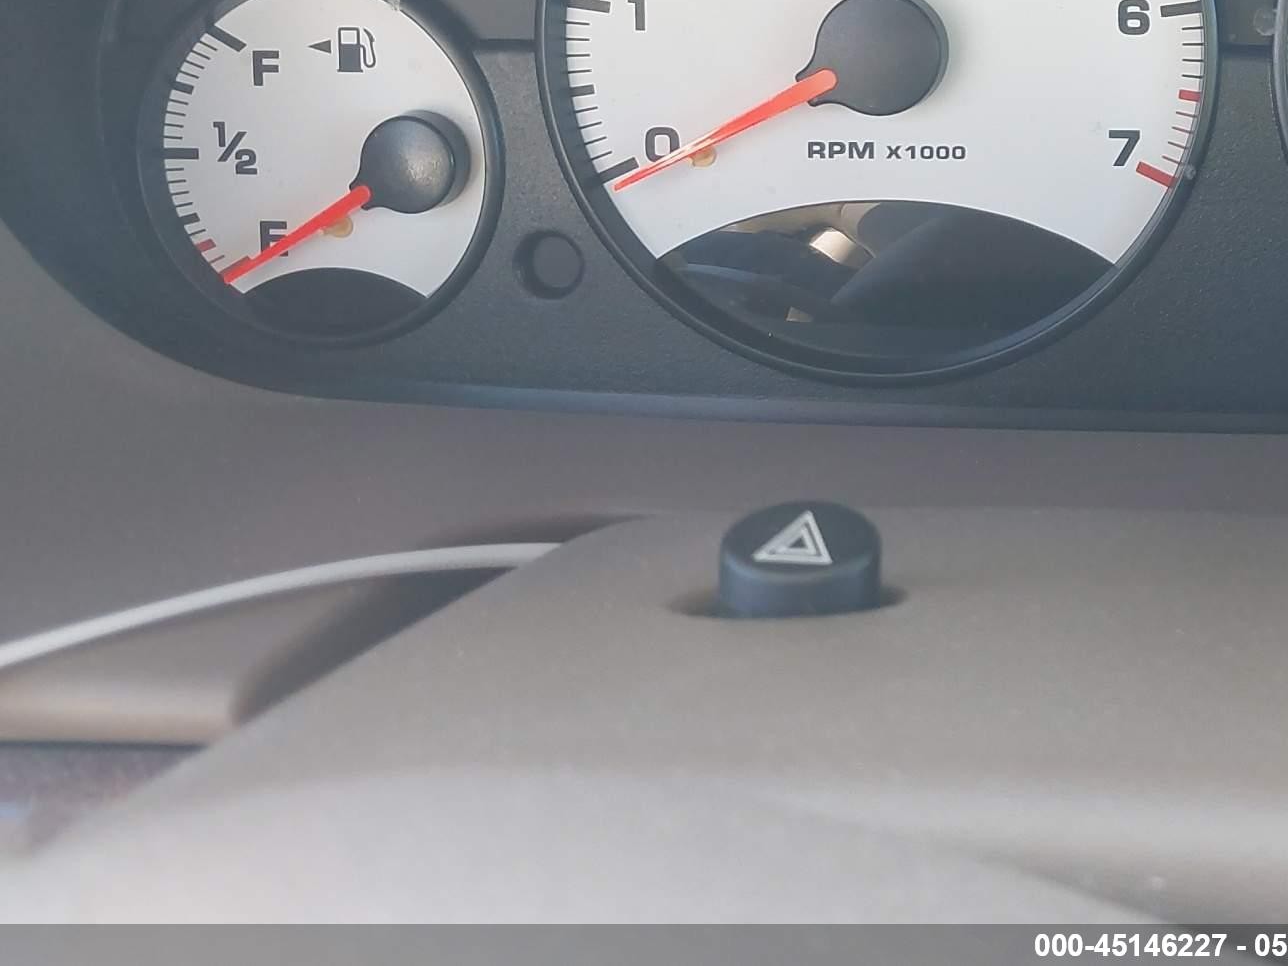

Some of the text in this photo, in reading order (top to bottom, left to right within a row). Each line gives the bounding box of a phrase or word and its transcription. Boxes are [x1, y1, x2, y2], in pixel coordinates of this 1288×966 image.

[252, 50, 279, 86] F
[643, 126, 681, 164] 0
[807, 141, 875, 160] RPM
[1108, 130, 1141, 167] 7
[259, 221, 289, 256] E
